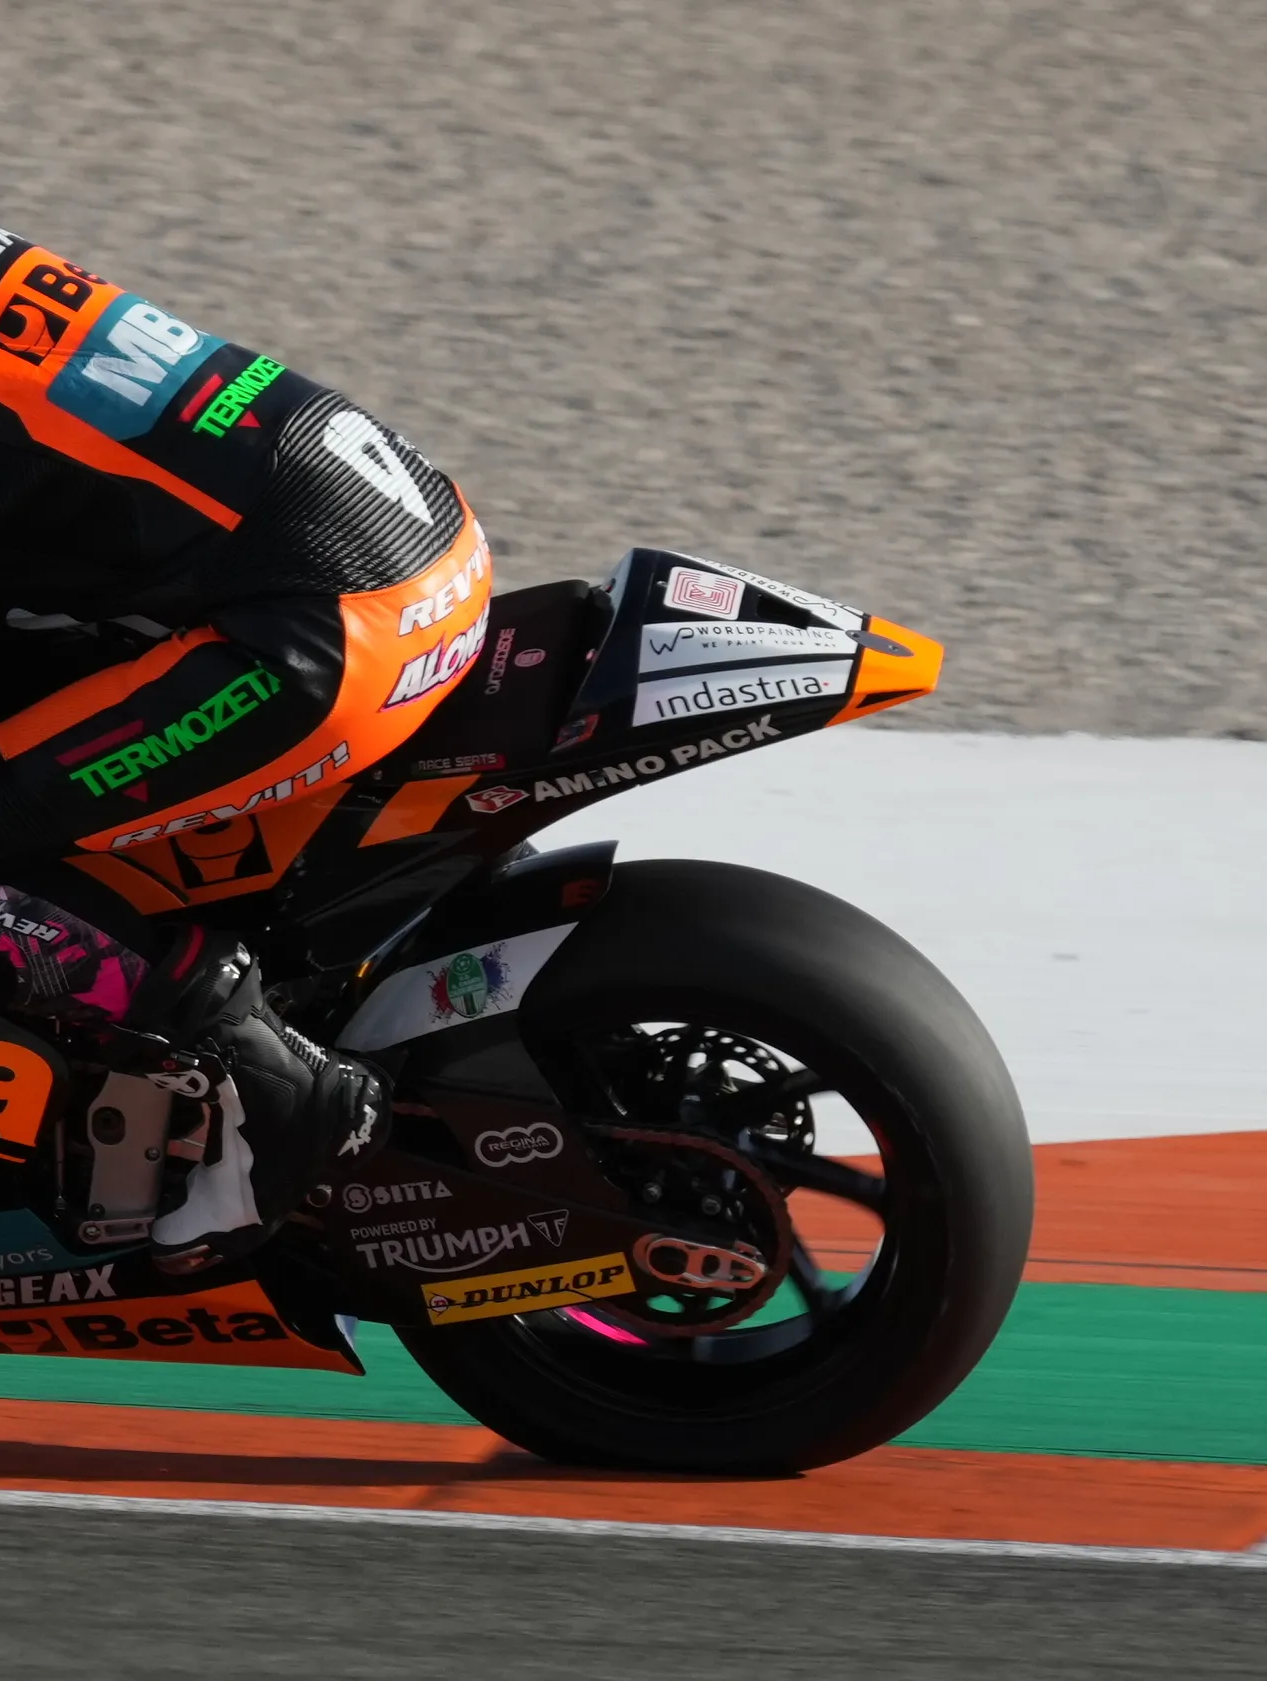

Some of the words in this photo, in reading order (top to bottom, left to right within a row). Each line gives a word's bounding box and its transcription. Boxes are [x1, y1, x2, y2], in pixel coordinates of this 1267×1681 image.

[21, 261, 108, 313] Be
[192, 354, 286, 438] TERMOZE
[695, 626, 835, 640] WORLDPAINTING
[417, 757, 452, 771] RACE
[455, 752, 498, 768] SEATS
[670, 713, 783, 766] PACK
[110, 739, 351, 850] REV'IT!
[372, 1179, 454, 1206] SITTA
[350, 1219, 418, 1241] POWERED
[420, 1217, 438, 1232] BY
[356, 1221, 532, 1273] TRIUMPH
[461, 1264, 625, 1309] DUNLOP
[61, 1307, 291, 1352] Beta
